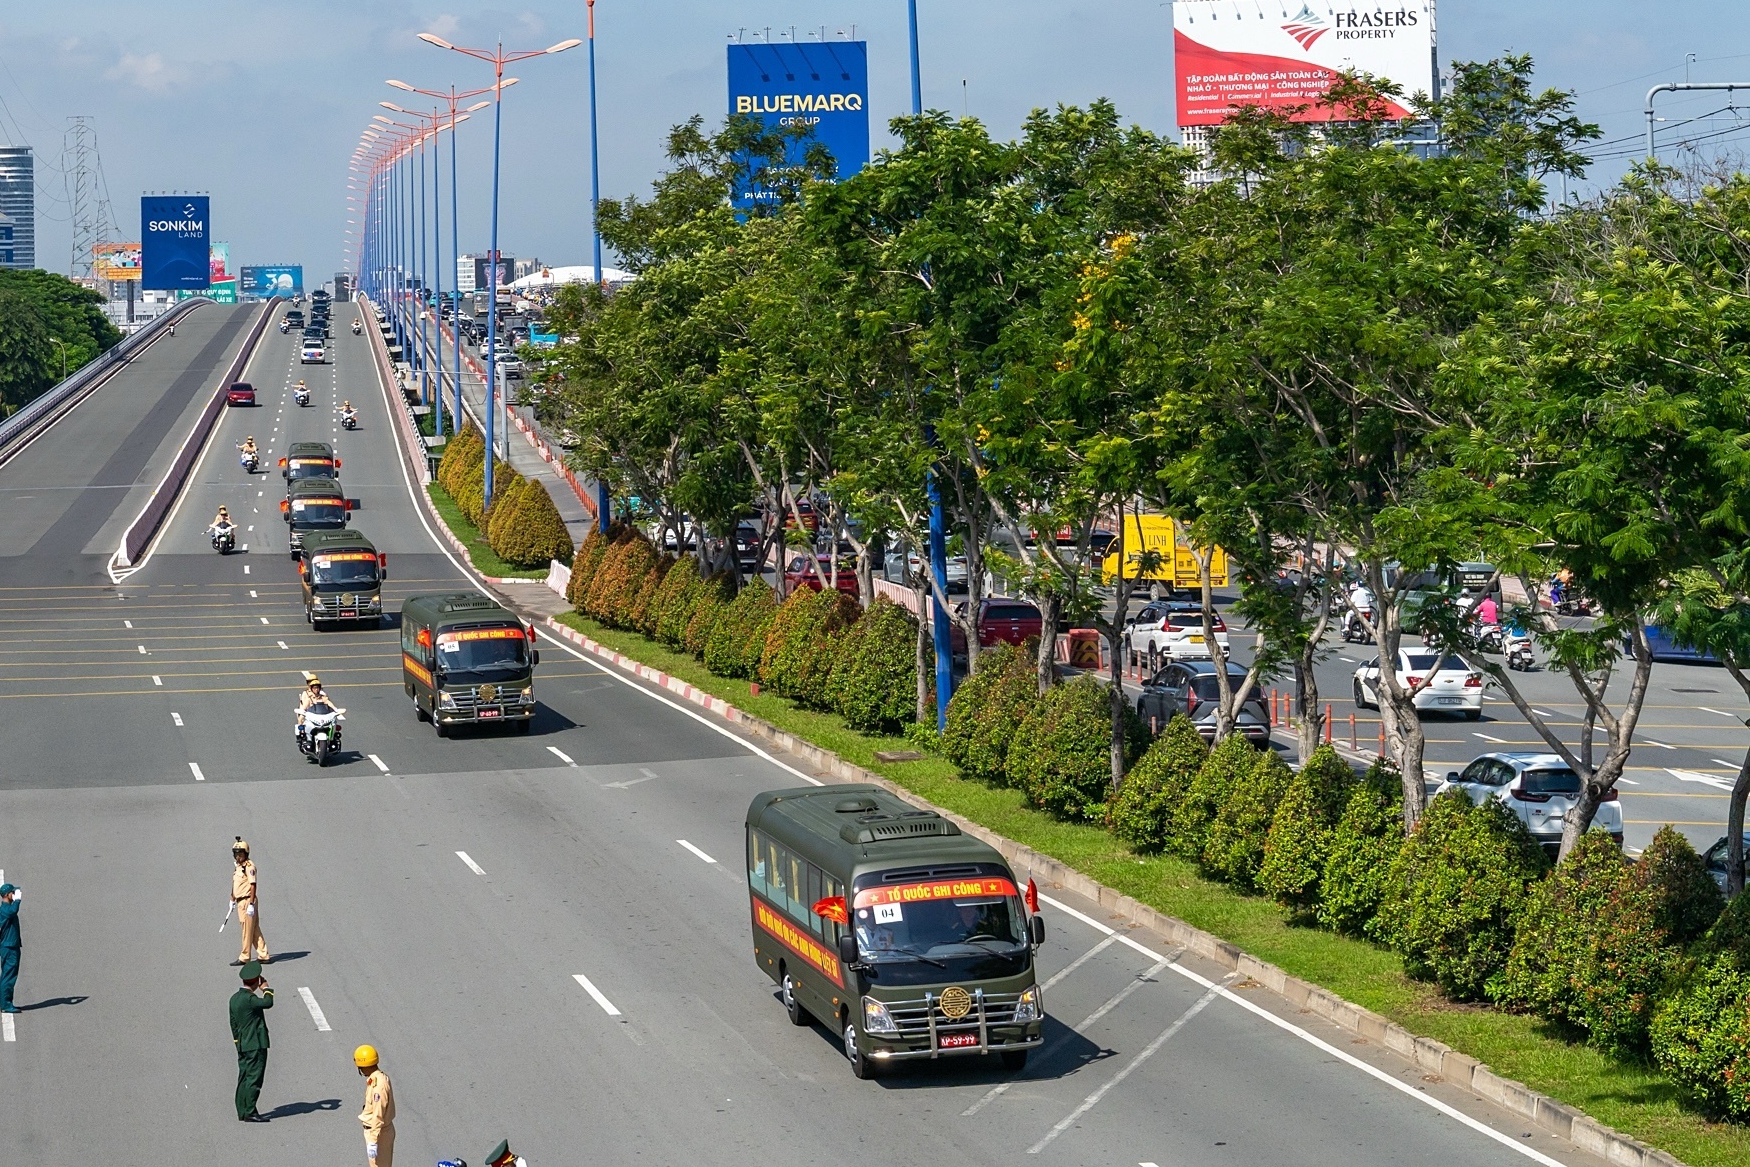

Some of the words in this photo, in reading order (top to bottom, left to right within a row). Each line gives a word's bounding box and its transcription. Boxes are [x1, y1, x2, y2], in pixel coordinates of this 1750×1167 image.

[1336, 11, 1418, 28] FRASERS
[1336, 29, 1396, 40] PROPERTY
[1186, 75, 1202, 85] TẬP
[1203, 73, 1227, 83] ĐOÀN
[1288, 71, 1311, 79] TOÀN
[1187, 84, 1204, 93] NHÀ
[1276, 81, 1299, 89] CÔNG
[736, 93, 863, 113] BLUEMARQ
[779, 116, 821, 127] GROUP
[149, 220, 203, 232] SONKIM
[886, 885, 901, 902] TỔ
[903, 883, 932, 901] QUỐC
[933, 885, 951, 897] GHI
[953, 882, 982, 896] CÔNG
[881, 907, 895, 919] 04
